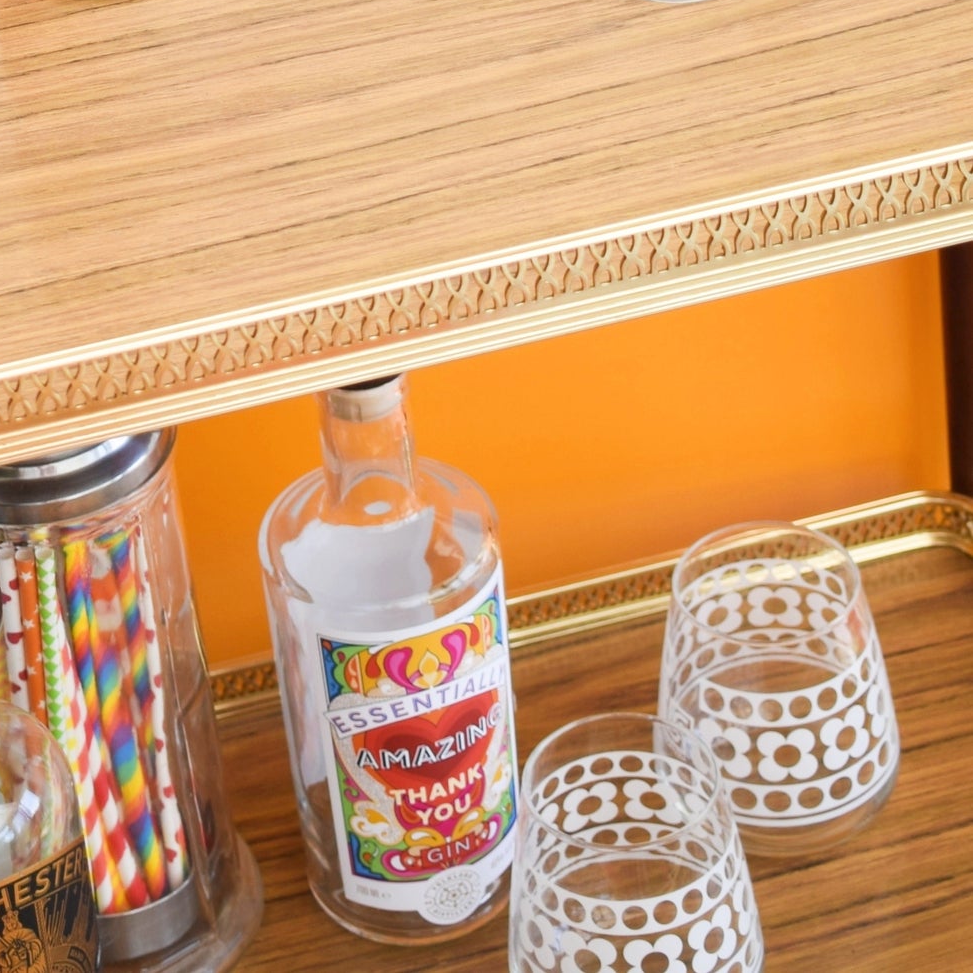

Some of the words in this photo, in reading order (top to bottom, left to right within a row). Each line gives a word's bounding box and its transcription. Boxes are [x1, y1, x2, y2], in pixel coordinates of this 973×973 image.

[356, 702, 503, 770] AMAZING
[390, 763, 484, 806] THANK
[416, 797, 471, 826] YOU
